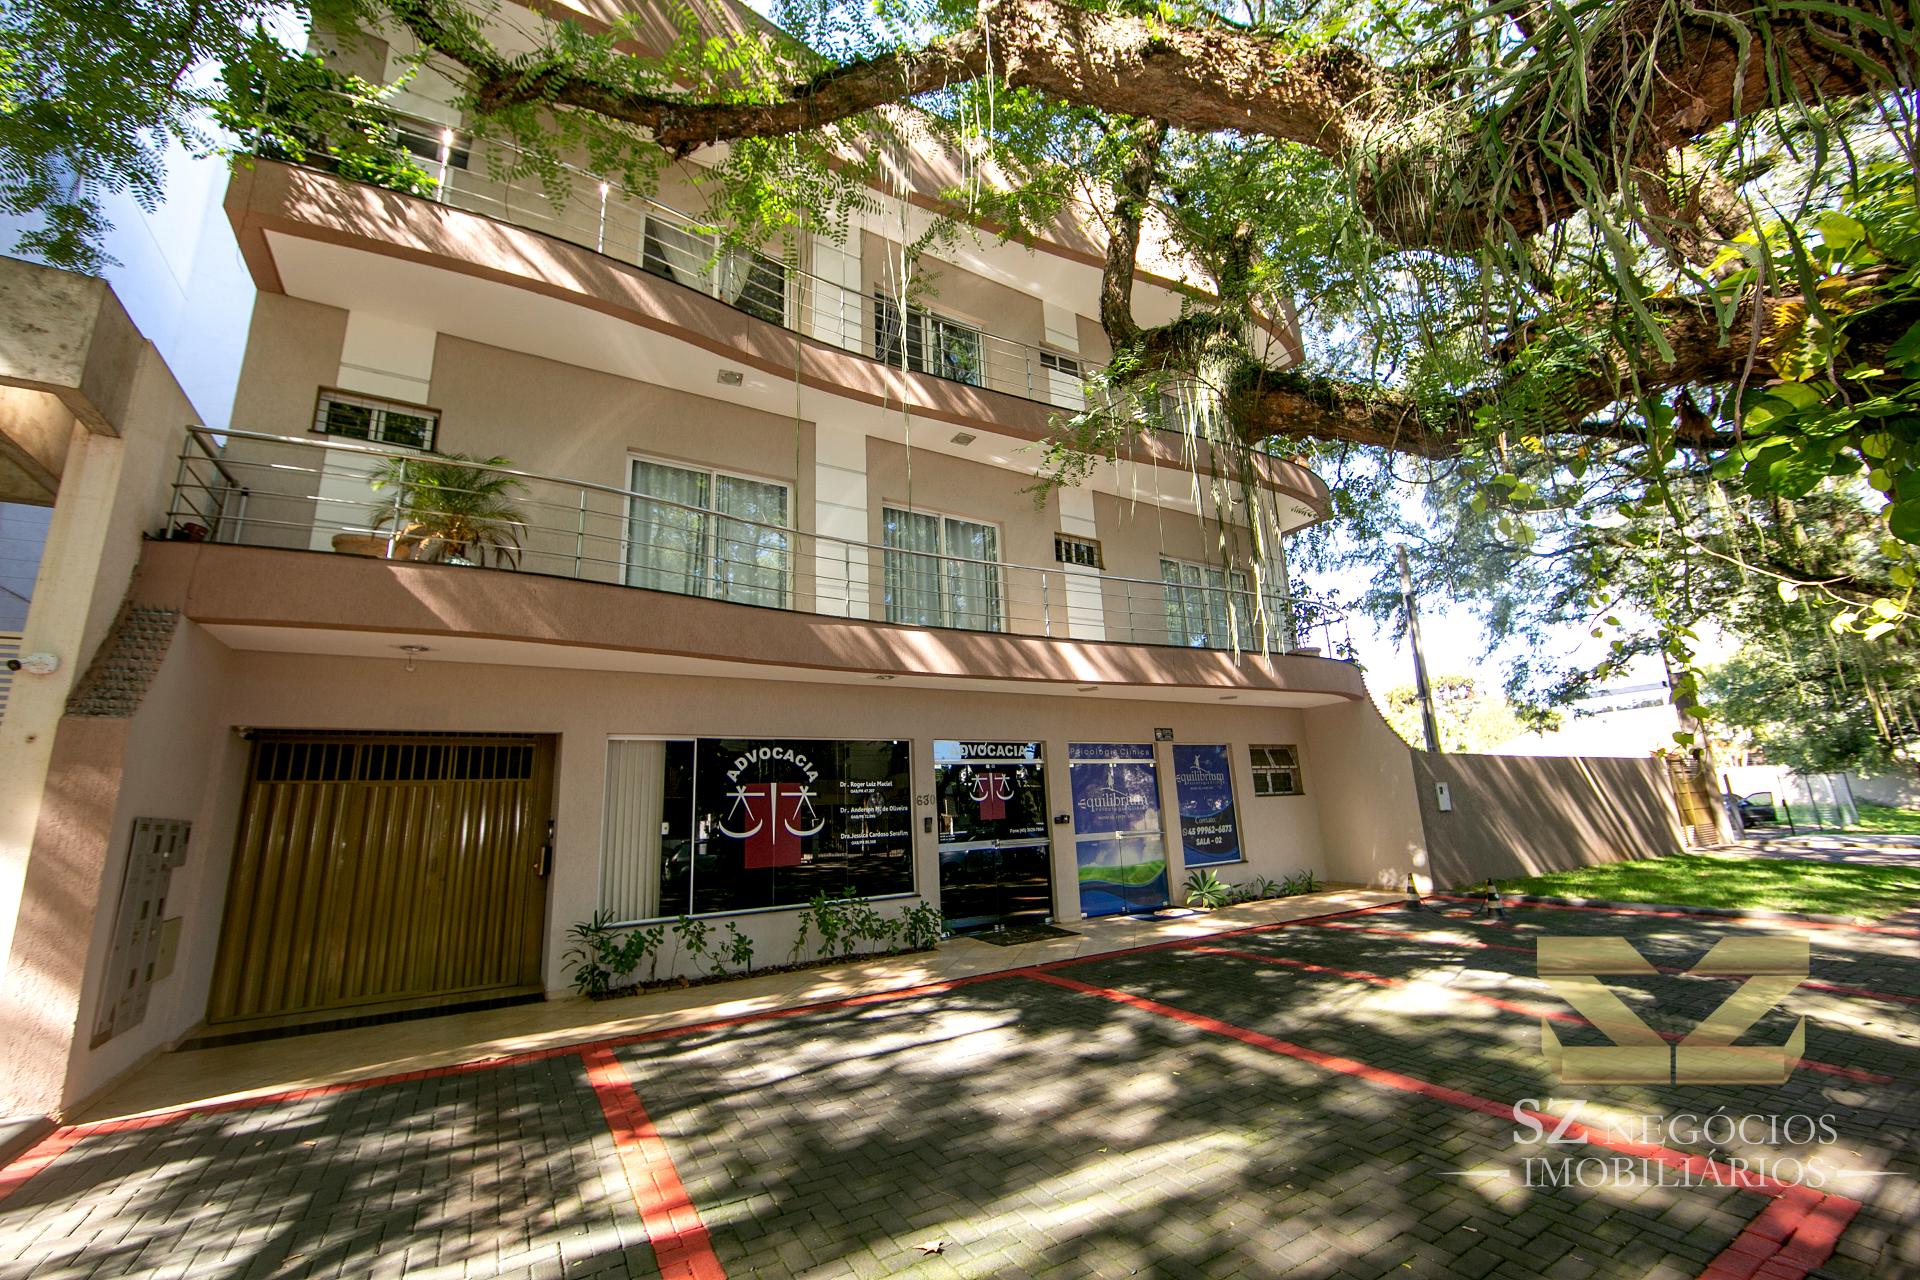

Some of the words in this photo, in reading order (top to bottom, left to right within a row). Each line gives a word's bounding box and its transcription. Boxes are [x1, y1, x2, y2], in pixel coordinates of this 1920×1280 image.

[726, 747, 819, 783] ADVOCACIA
[916, 794, 936, 806] 630
[1196, 838, 1210, 846] SALA
